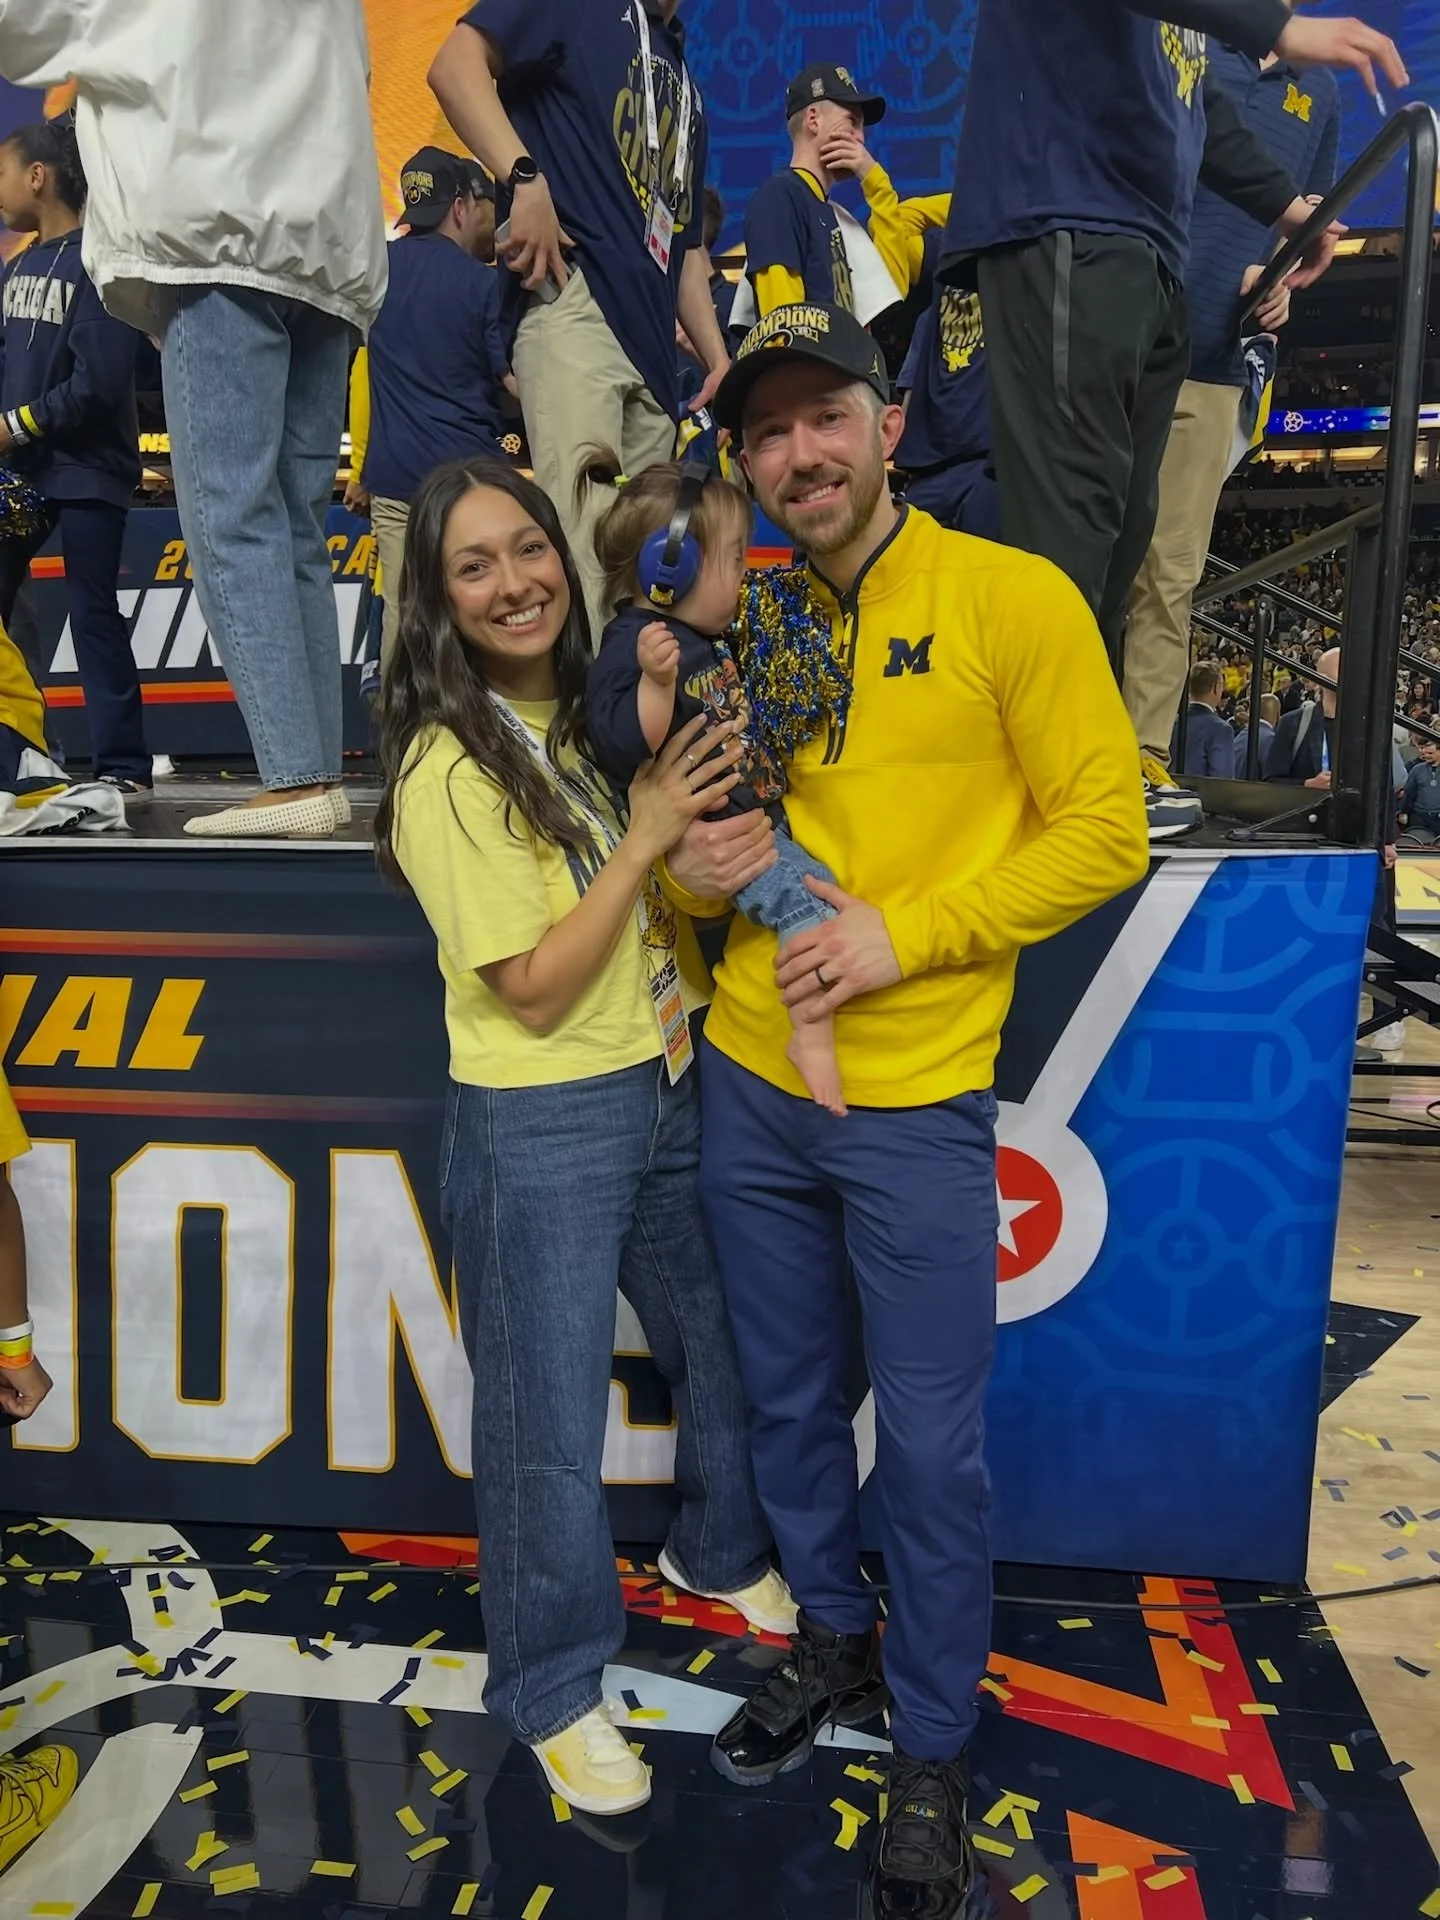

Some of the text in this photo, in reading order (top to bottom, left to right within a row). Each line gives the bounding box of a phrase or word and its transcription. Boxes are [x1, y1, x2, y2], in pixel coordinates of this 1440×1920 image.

[1282, 83, 1312, 122] M
[883, 632, 935, 678] M
[0, 974, 207, 1071] AL
